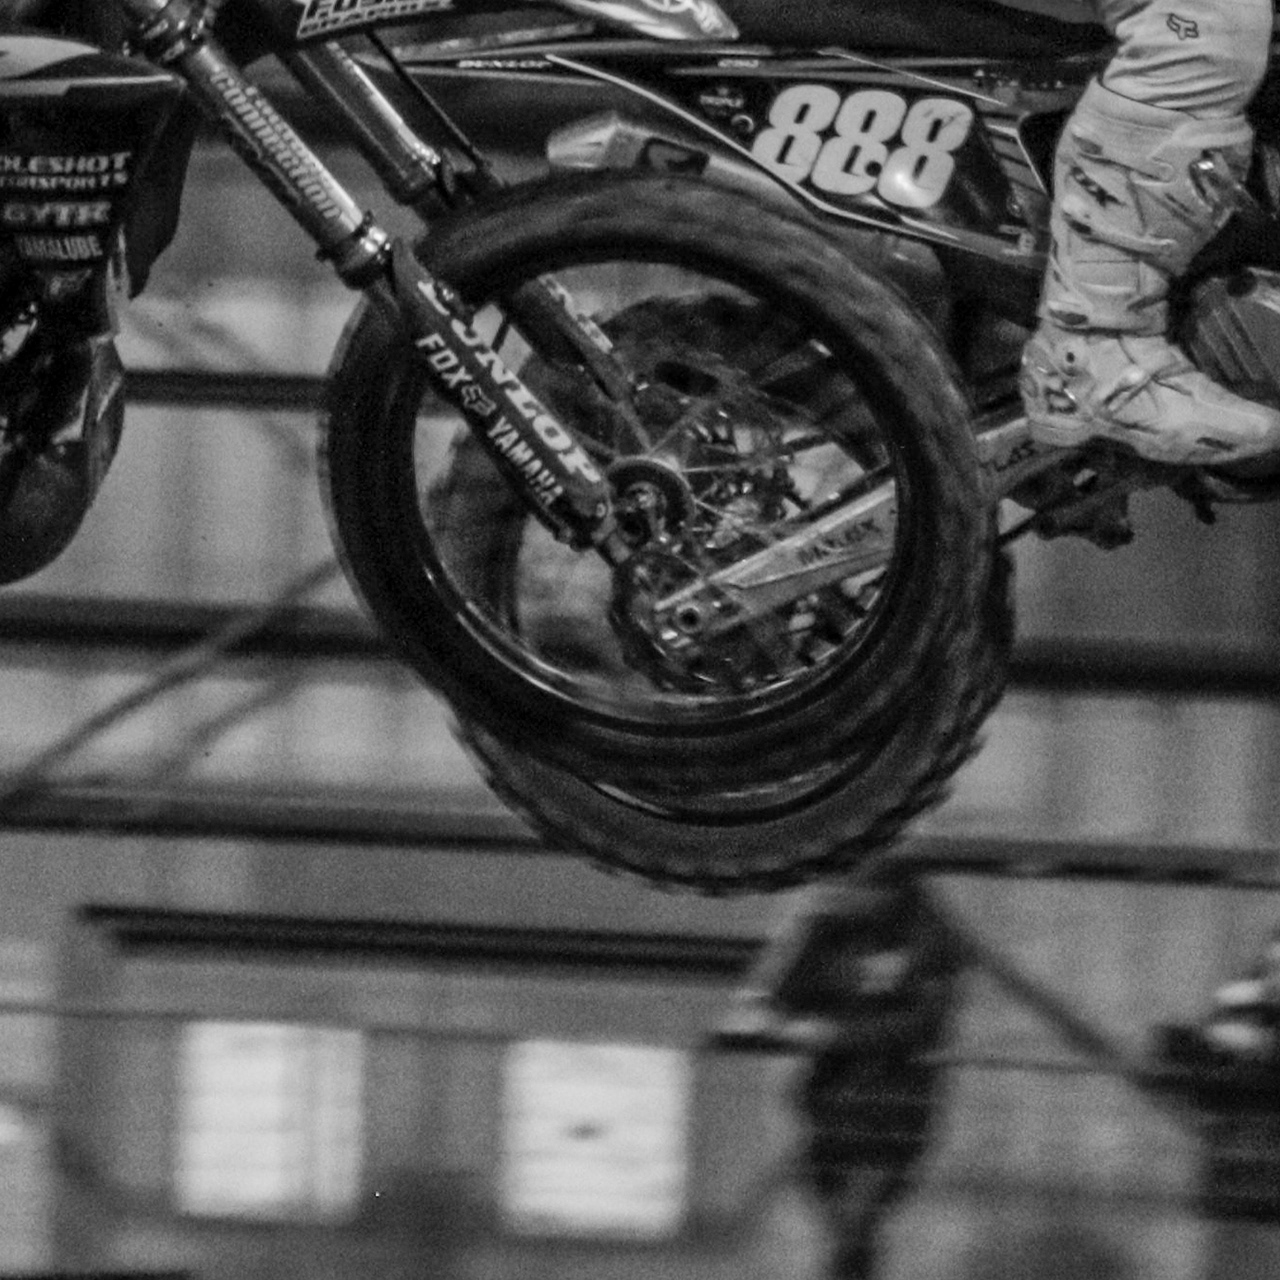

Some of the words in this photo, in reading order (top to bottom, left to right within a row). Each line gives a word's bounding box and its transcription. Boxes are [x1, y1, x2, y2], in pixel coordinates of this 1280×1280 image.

[750, 84, 974, 210] 888
[416, 332, 473, 389] FOX
[487, 416, 564, 506] YAMAHA
